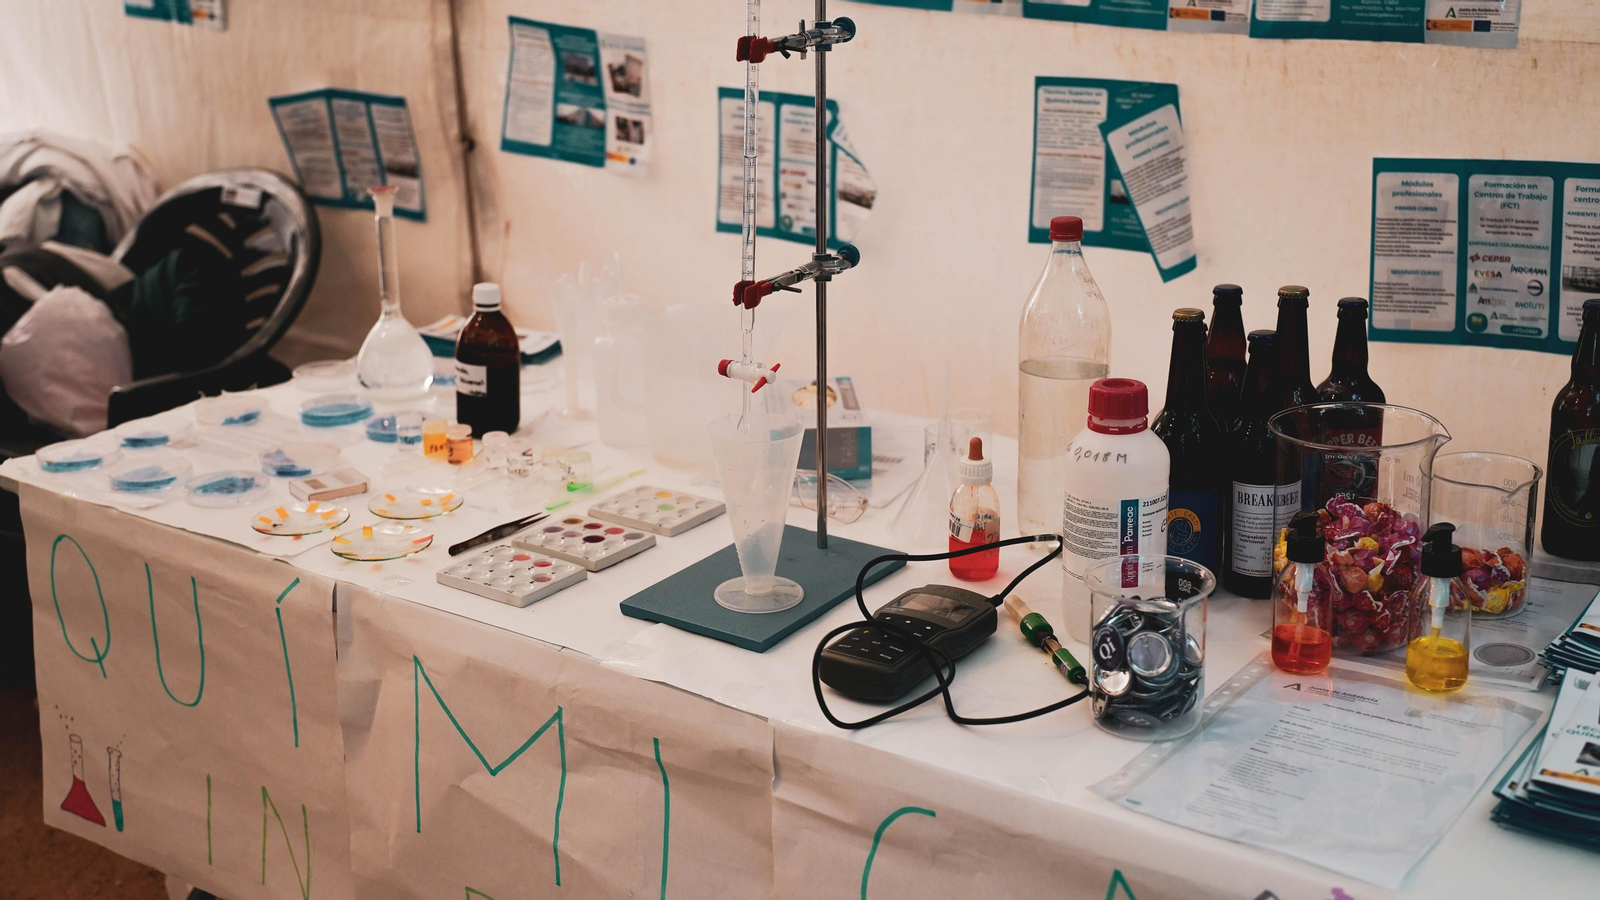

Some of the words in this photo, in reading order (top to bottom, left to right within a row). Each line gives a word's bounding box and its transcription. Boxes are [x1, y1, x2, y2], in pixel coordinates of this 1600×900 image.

[1401, 180, 1434, 188] Módulos
[1484, 181, 1526, 190] Formación
[1392, 190, 1443, 198] profesionales
[1517, 193, 1547, 201] Trabajo
[1500, 202, 1520, 210] (FCT)
[1474, 270, 1502, 278] EVESA
[1116, 453, 1127, 463] M
[1238, 491, 1273, 506] BREAK
[1184, 511, 1198, 526] CASO
[1124, 506, 1134, 542] Panreac
[1238, 532, 1267, 540] Composición
[1099, 638, 1116, 660] Qi
[1308, 685, 1329, 693] Junta
[1341, 691, 1379, 703] Andalucía
